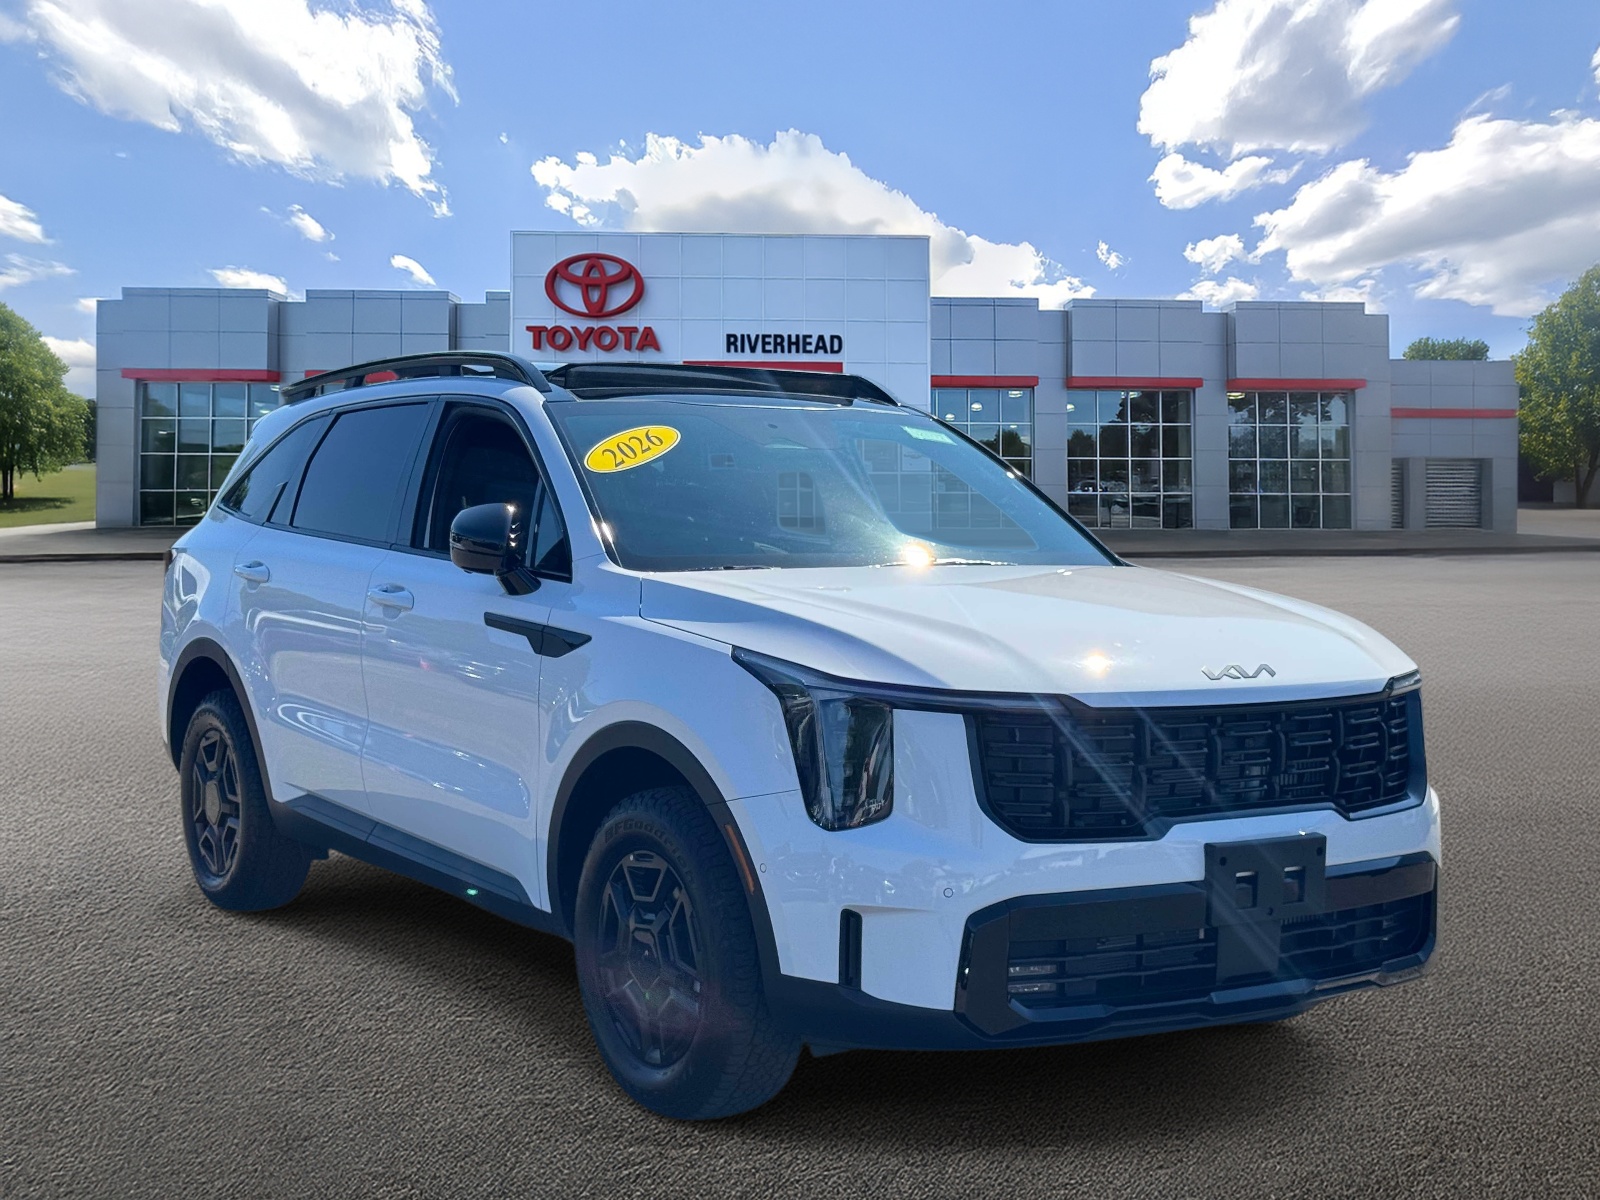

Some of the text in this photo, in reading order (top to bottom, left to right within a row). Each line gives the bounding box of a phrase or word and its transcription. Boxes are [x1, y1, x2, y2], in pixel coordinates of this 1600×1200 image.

[525, 325, 661, 352] TOYOTA
[725, 333, 843, 354] RIVERHEAD
[602, 429, 664, 468] 2026
